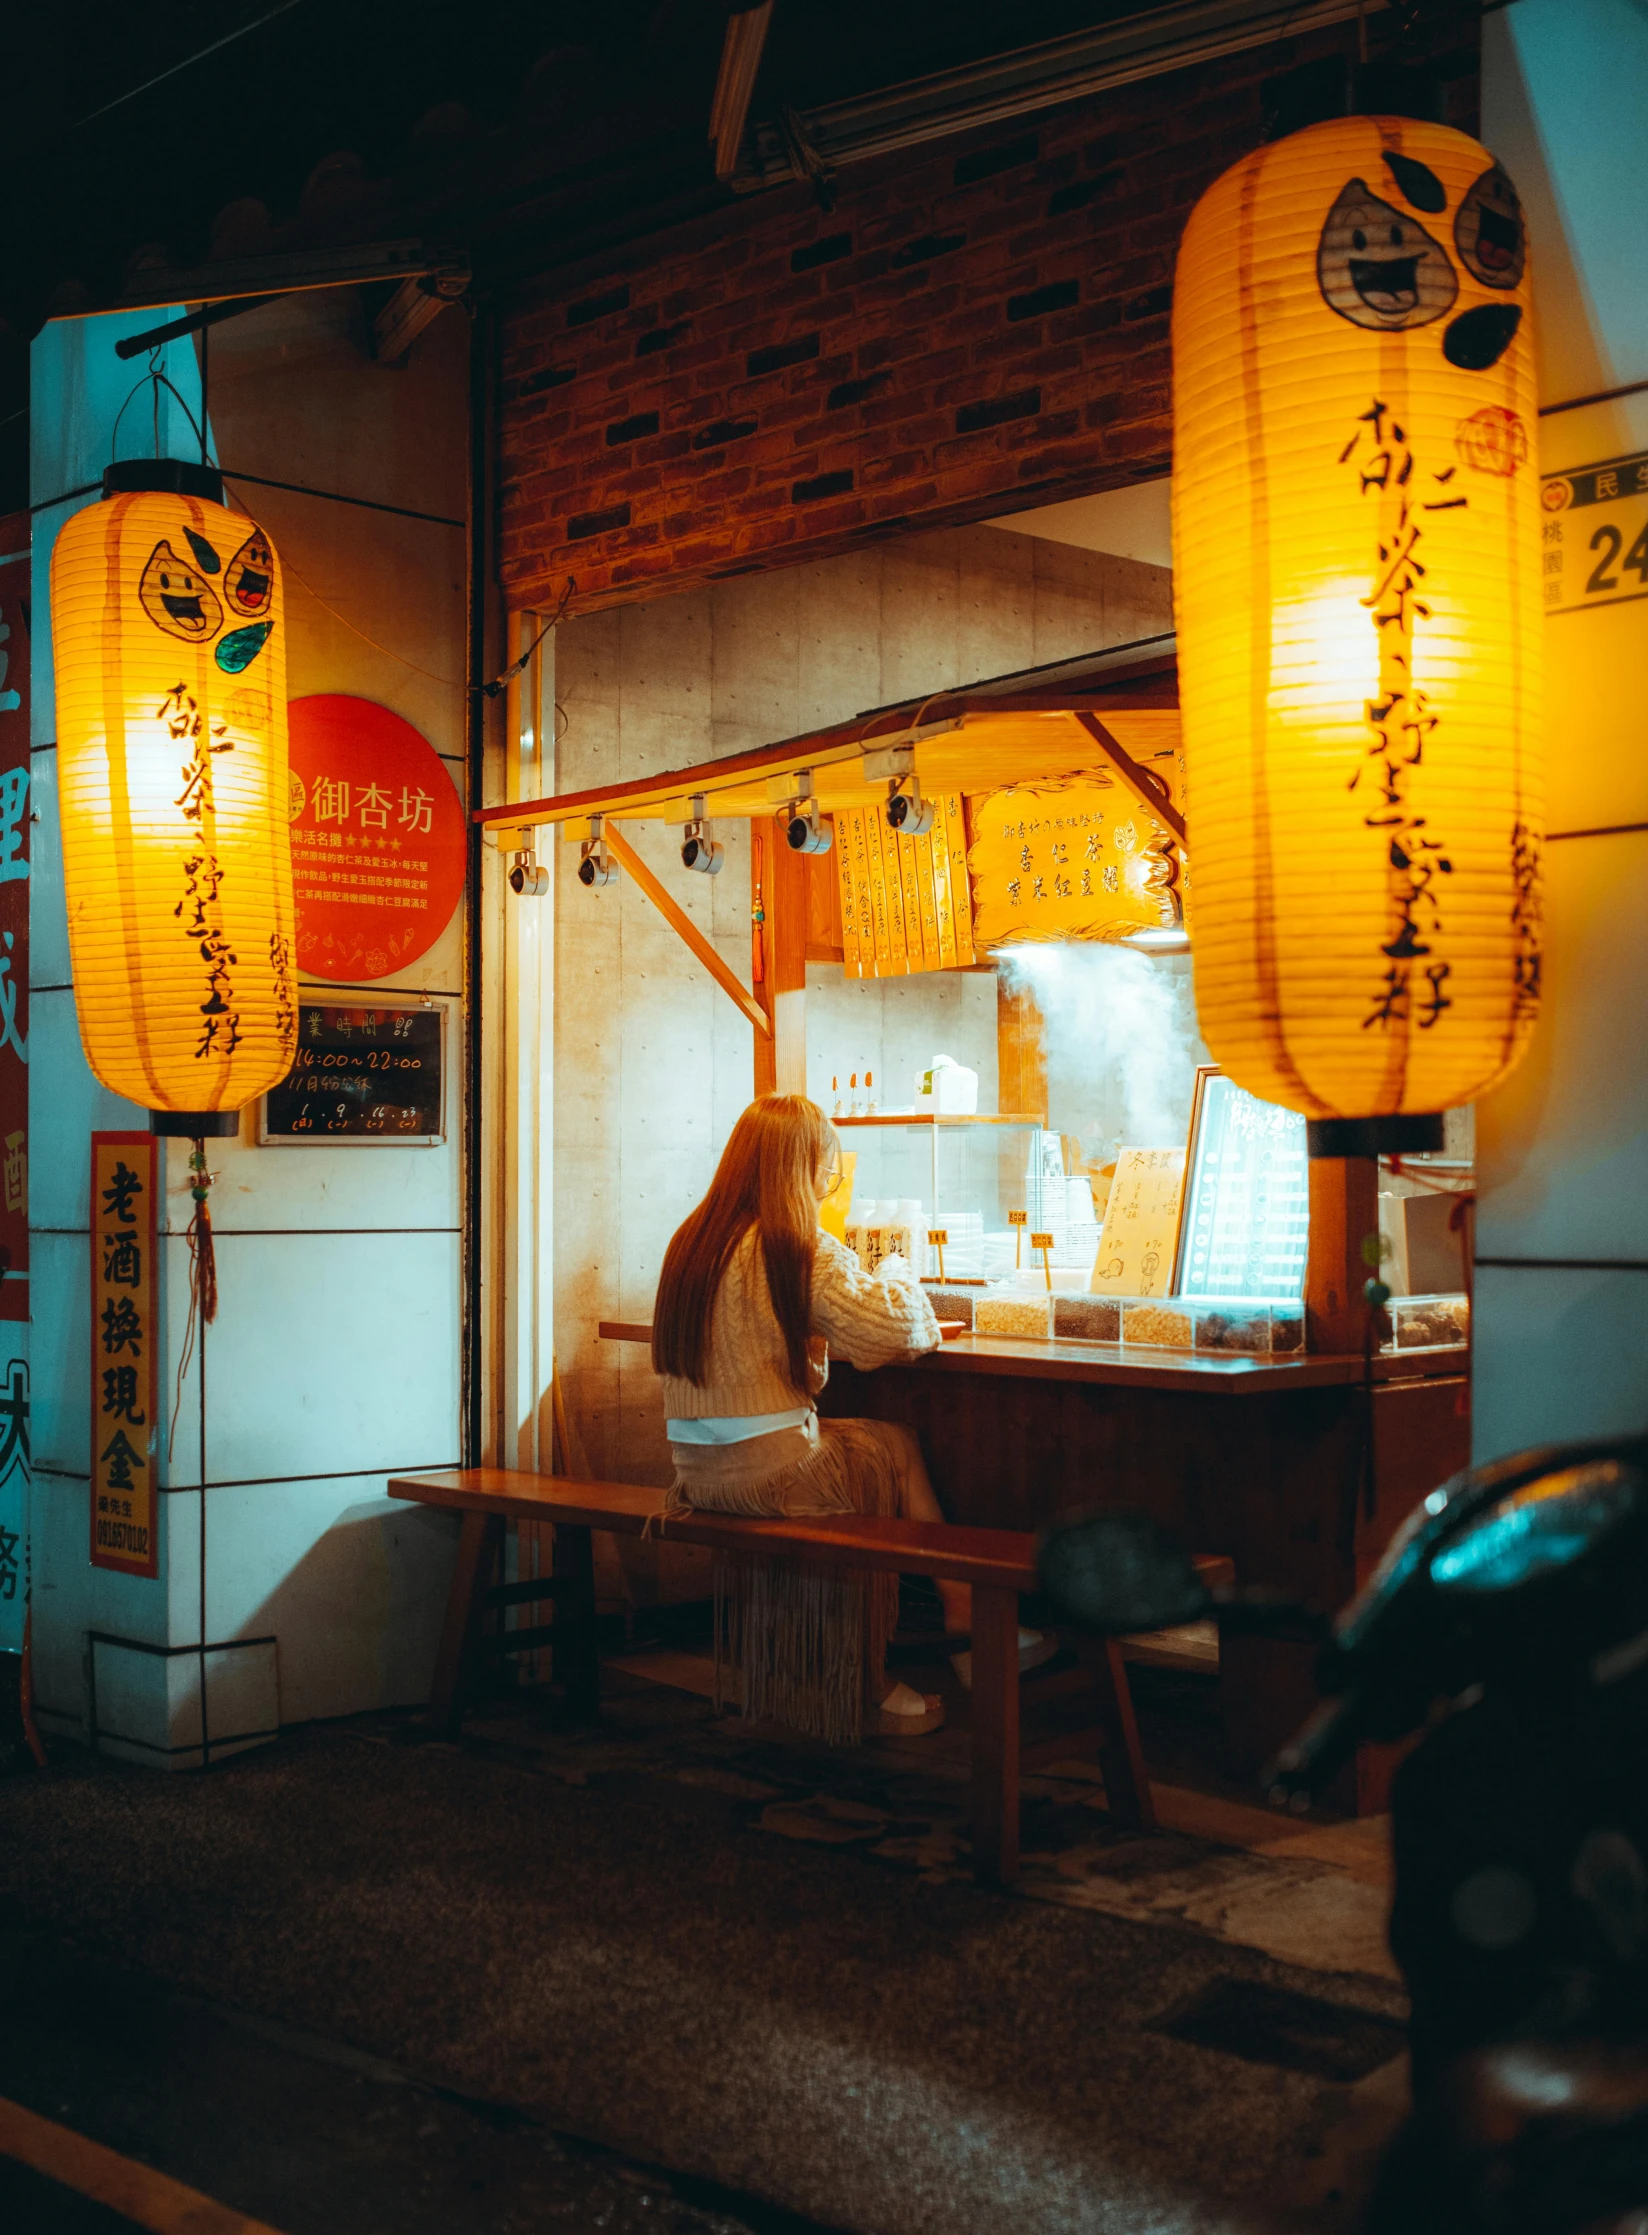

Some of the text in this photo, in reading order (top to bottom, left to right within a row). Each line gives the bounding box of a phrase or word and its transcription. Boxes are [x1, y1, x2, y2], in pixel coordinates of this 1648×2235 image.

[310, 775, 435, 833] 御杏坊
[1003, 811, 1105, 840] 御杏坊の原味堅持
[1020, 833, 1103, 873] 杏仁茶
[100, 1160, 147, 1492] 老酒換現金
